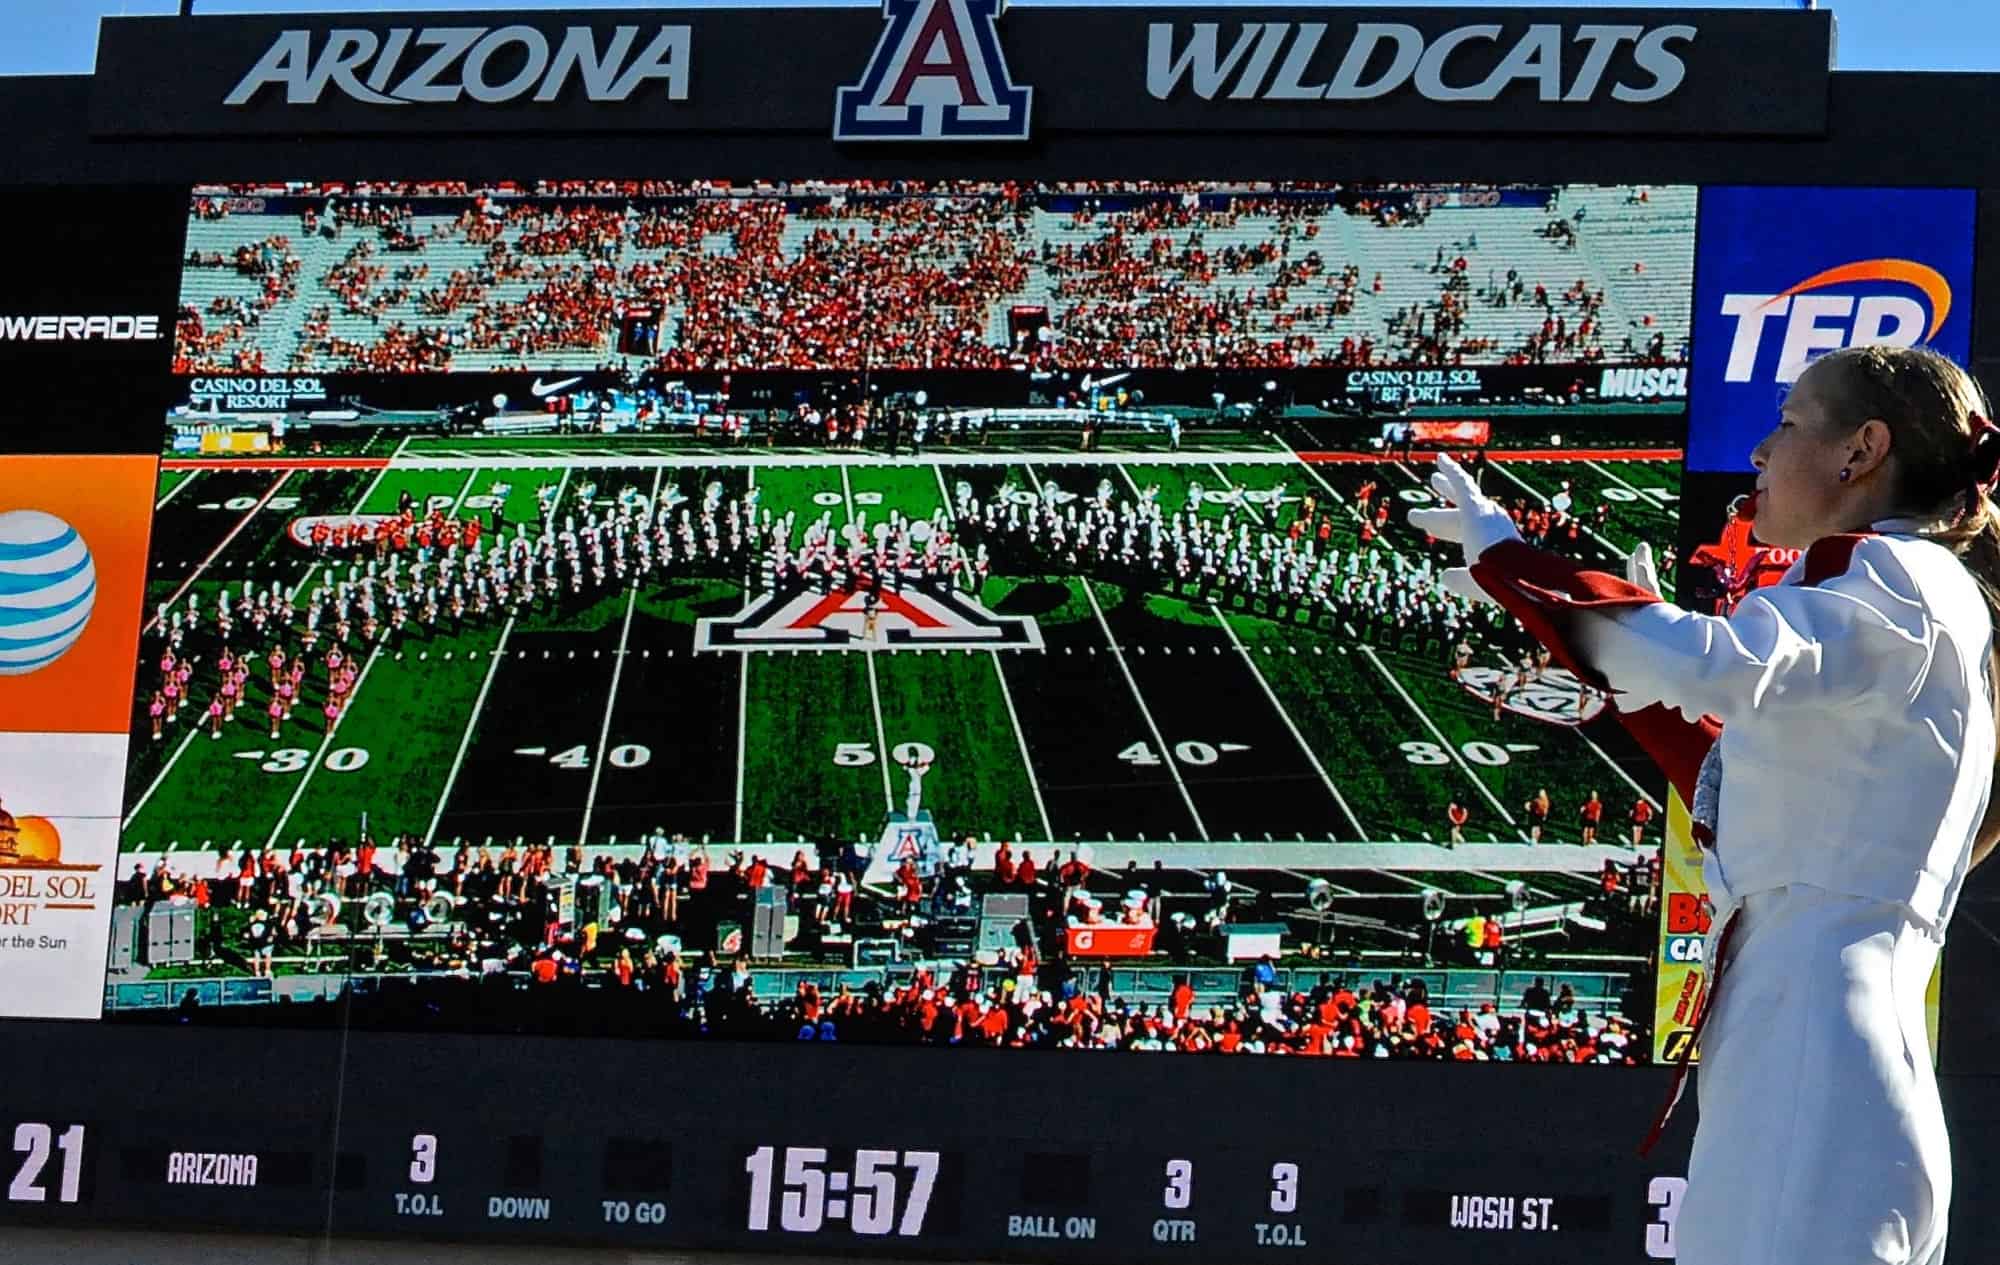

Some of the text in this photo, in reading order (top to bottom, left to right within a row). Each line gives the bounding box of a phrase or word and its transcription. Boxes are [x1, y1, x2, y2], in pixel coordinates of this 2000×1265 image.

[223, 25, 692, 105] ARIZONA
[1145, 23, 1697, 103] WILDCATS
[190, 378, 325, 393] CASINO DEL SOL
[1416, 371, 1447, 387] DEL
[1449, 370, 1481, 386] SOL
[226, 394, 290, 409] RESORT
[45, 876, 96, 899] SOL
[12, 934, 35, 948] the
[39, 936, 67, 949] Sun
[8, 1122, 85, 1202] 21
[167, 1152, 258, 1186] ARIZONA
[410, 1134, 437, 1182] 3
[746, 1146, 940, 1236] 15:57
[1165, 1159, 1193, 1208] 3
[1271, 1162, 1298, 1212] 3
[395, 1193, 444, 1216] T.O.L
[488, 1196, 550, 1220] DOWN
[602, 1201, 666, 1224] TO GO
[1450, 1195, 1559, 1231] WASH ST.
[1008, 1215, 1096, 1239] BALL ON
[1153, 1219, 1196, 1242] QTR
[1255, 1223, 1306, 1246] T.O.L
